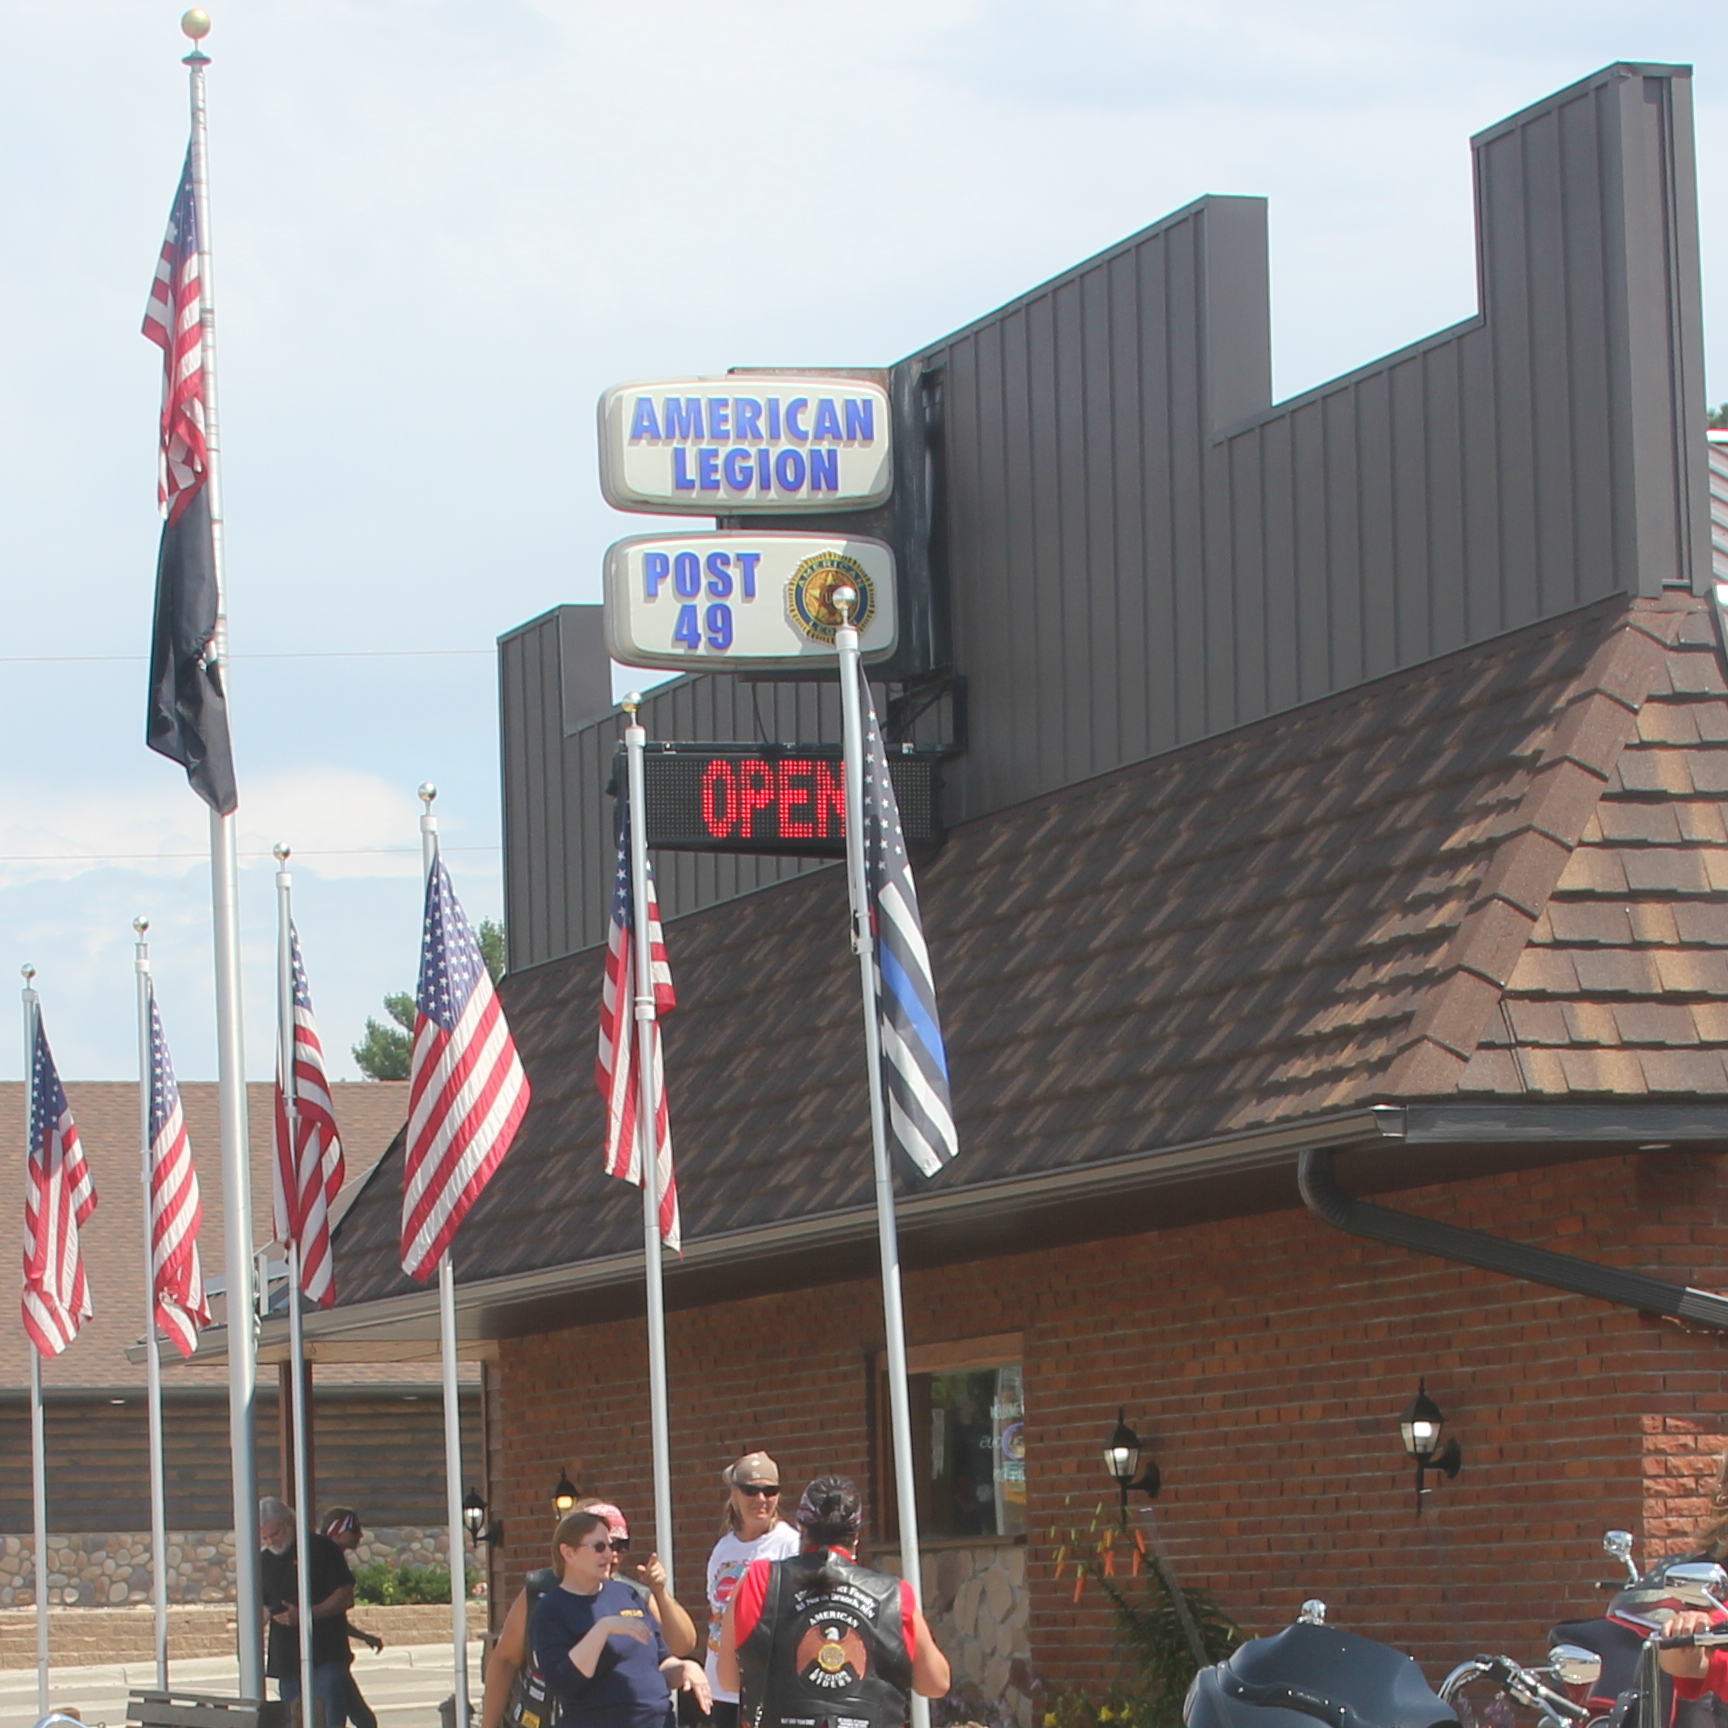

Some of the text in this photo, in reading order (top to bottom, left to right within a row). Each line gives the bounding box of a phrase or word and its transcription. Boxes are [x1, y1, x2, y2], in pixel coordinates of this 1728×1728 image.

[629, 396, 873, 441] AMERICAN
[673, 447, 839, 492] LEGION
[643, 551, 761, 598] POST
[672, 603, 735, 651] 49
[701, 759, 846, 837] OPEN
[809, 1610, 860, 1629] AMERICAN
[808, 1671, 853, 1689] RIDERS
